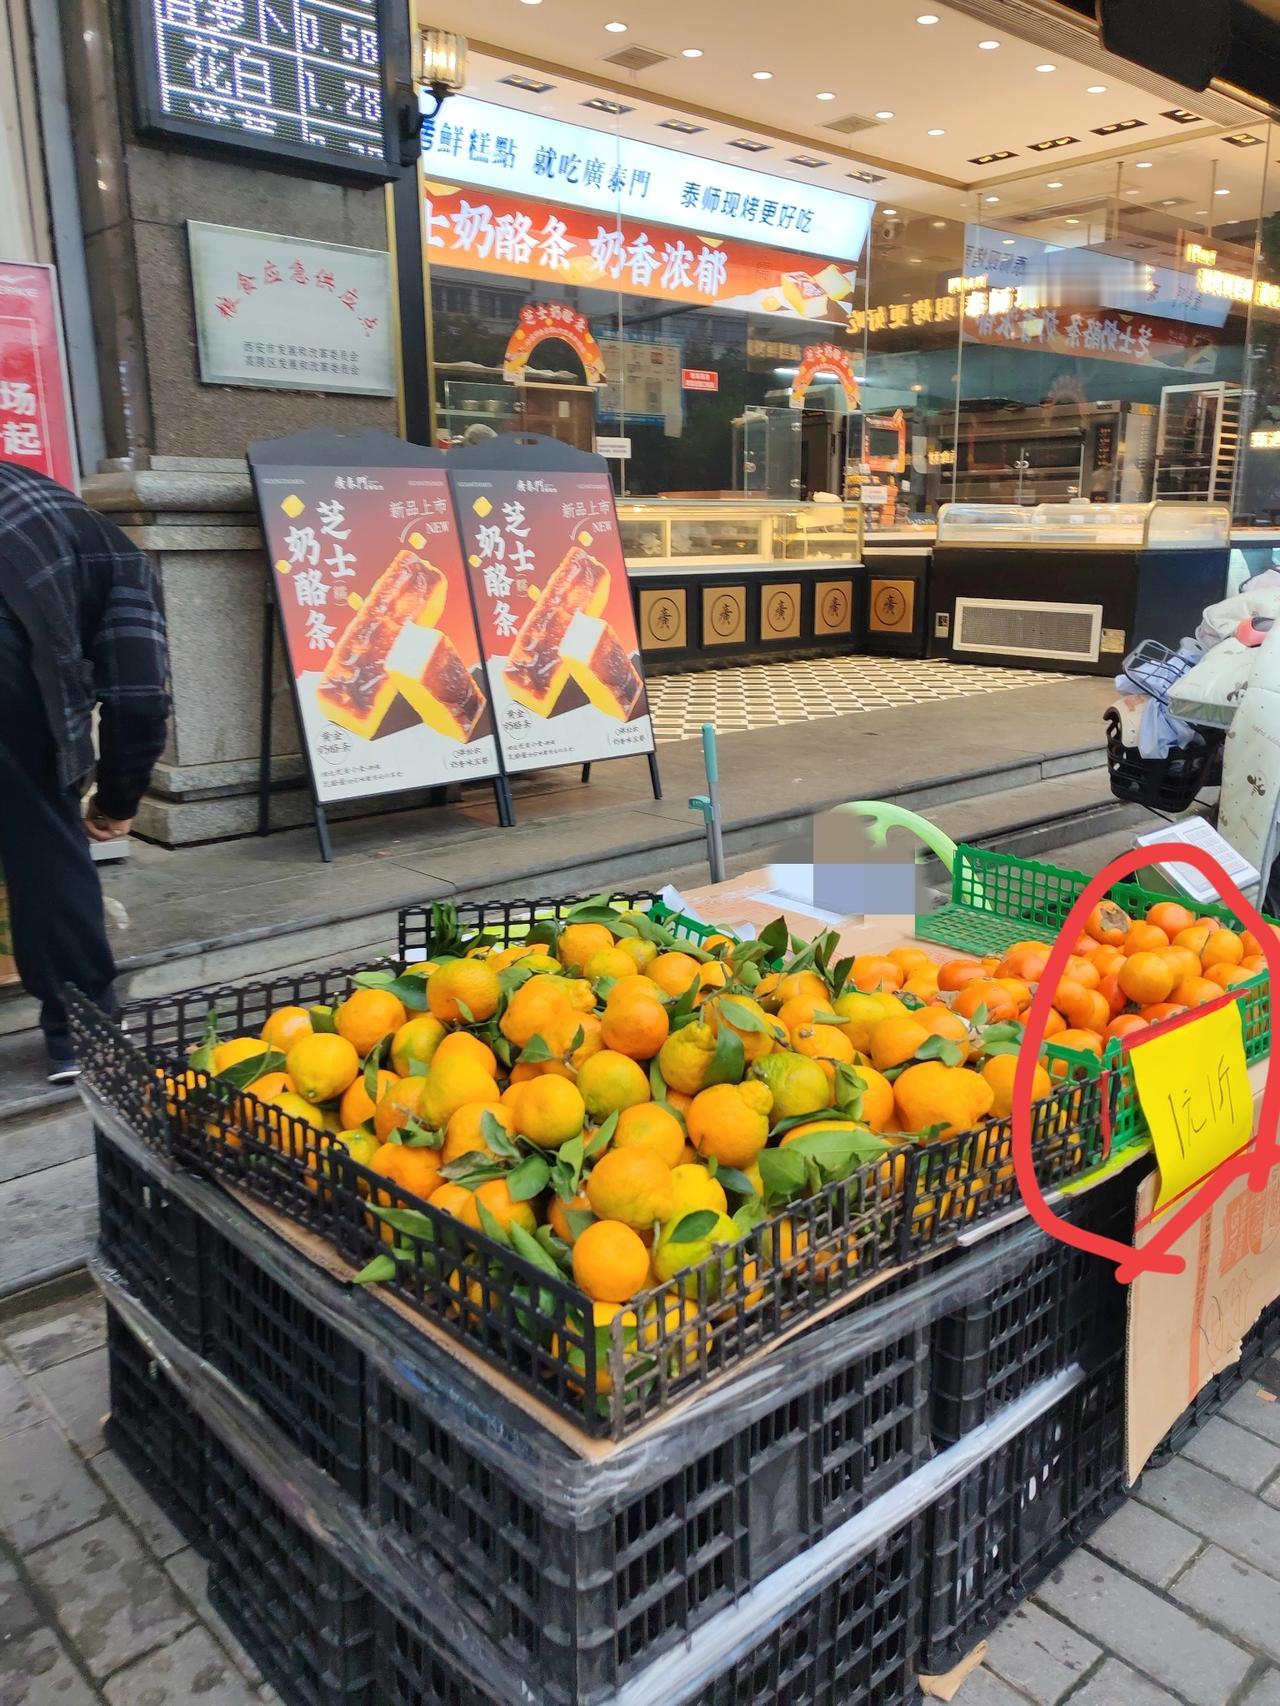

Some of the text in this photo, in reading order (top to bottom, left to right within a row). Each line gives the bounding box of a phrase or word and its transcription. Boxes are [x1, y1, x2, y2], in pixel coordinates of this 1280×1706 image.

[302, 12, 379, 65] 0.58
[184, 35, 273, 104] 花白
[303, 71, 383, 121] 1.28
[680, 181, 816, 234] 泰师现烤更好吃
[588, 225, 729, 297] 奶香浓郁
[315, 499, 358, 578] 芝士
[388, 497, 448, 519] 新品上市
[425, 520, 450, 535] NEW
[501, 501, 536, 572] 芝士
[561, 499, 611, 518] 新品上市
[592, 520, 613, 533] NEW
[283, 525, 337, 651] 奶酪条
[475, 524, 520, 637] 奶酪条
